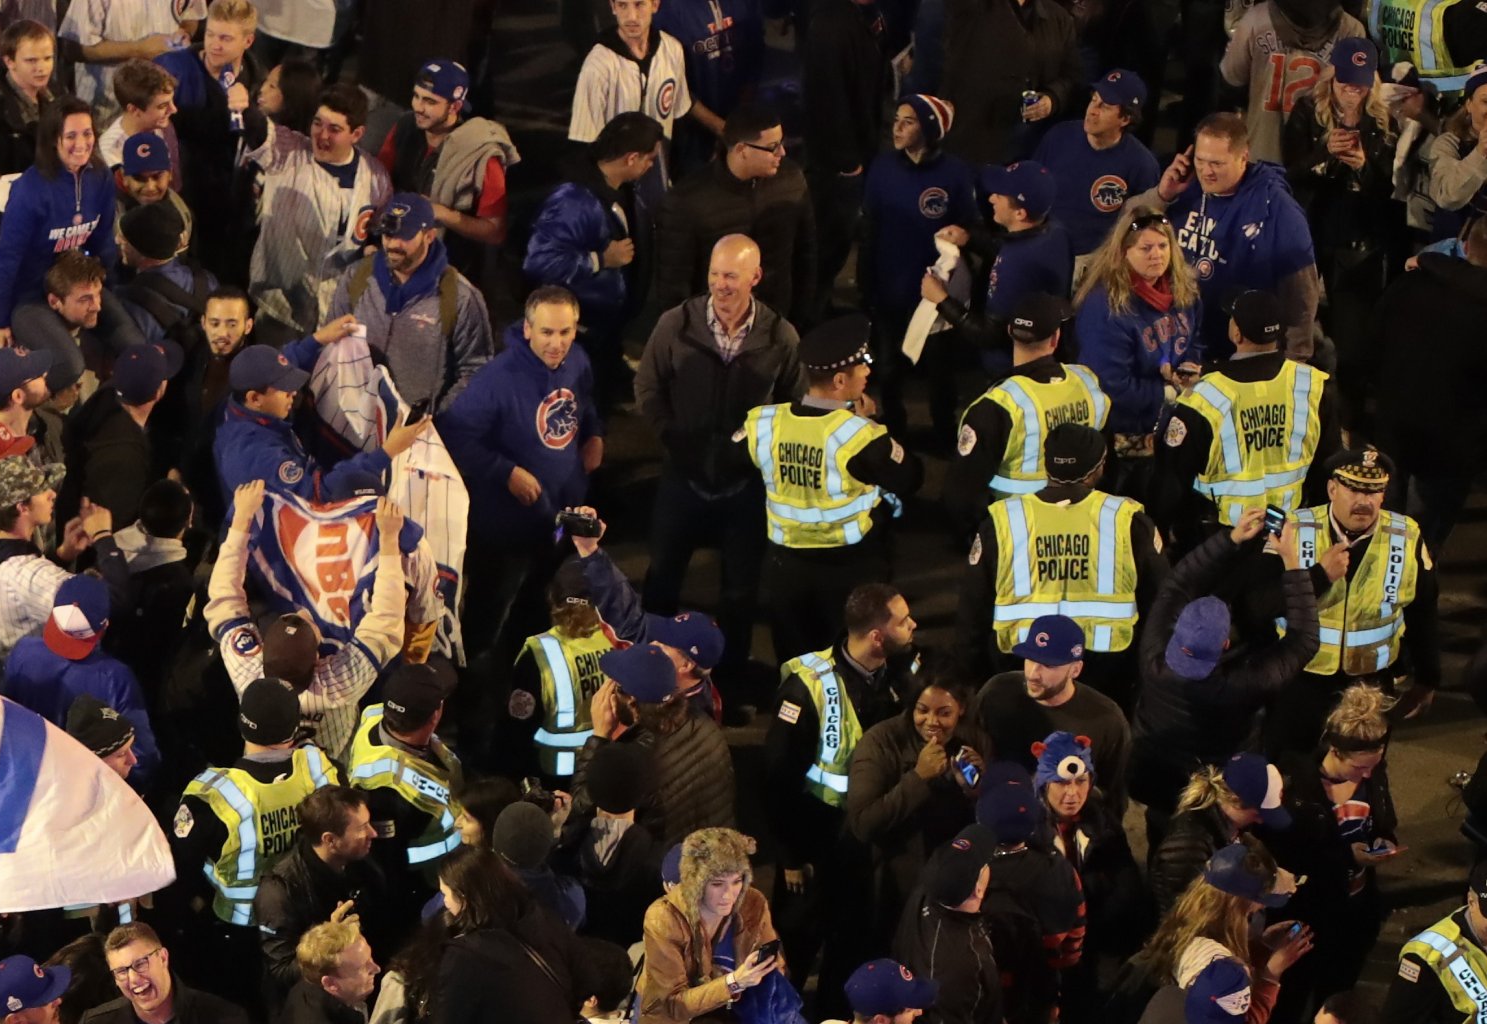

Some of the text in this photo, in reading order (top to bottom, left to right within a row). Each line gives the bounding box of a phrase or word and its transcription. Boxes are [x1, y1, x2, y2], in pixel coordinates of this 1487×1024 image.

[1383, 6, 1416, 30] CHICAGO
[1382, 27, 1415, 51] POLICE
[1350, 52, 1367, 67] C
[135, 143, 151, 158] C
[1014, 318, 1034, 328] CPD
[1045, 400, 1090, 430] CHICAGO
[1240, 404, 1286, 432] CHICAGO
[779, 442, 823, 468] CHICAGO
[780, 465, 822, 490] POLICE
[1035, 534, 1090, 559] CHICAGO
[1037, 559, 1089, 582] POLICE
[566, 596, 589, 606] CPD
[1035, 631, 1051, 648] C
